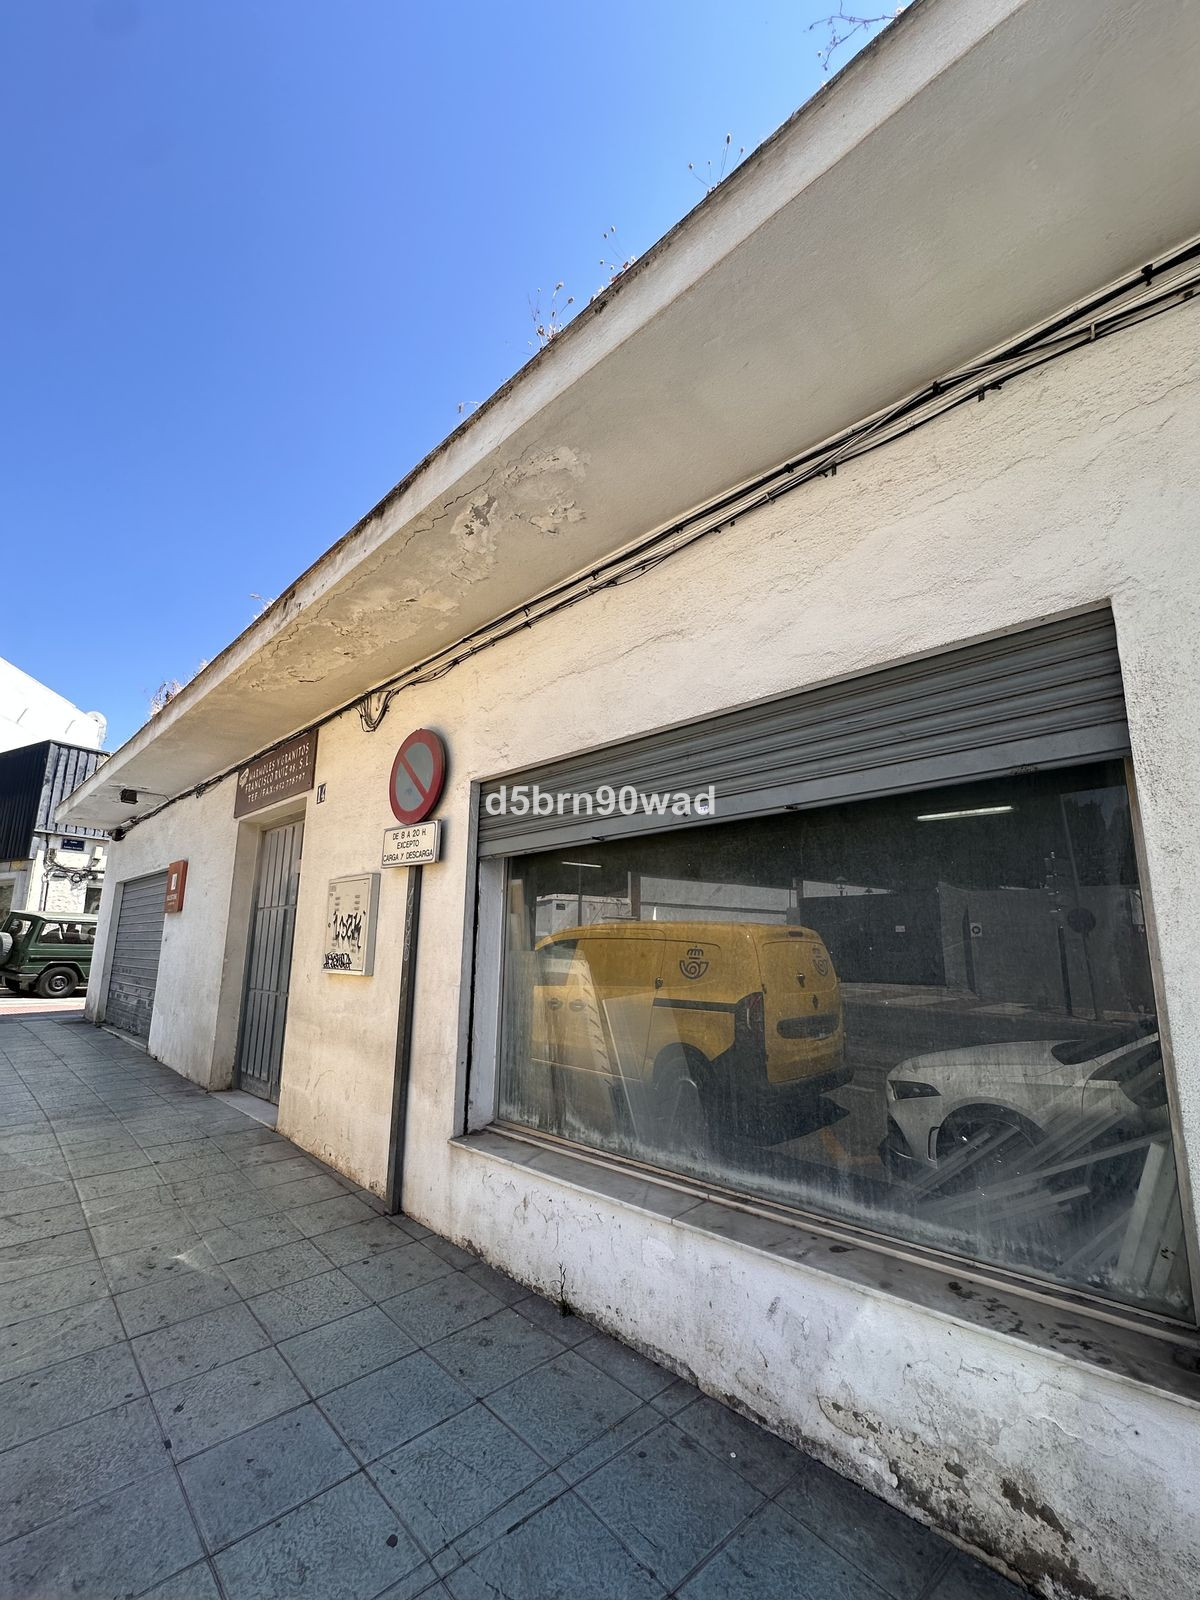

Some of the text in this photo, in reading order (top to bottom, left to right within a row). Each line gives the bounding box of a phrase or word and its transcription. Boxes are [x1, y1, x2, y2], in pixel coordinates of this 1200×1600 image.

[281, 742, 310, 766] GRANITOS
[245, 772, 274, 793] FRANCISCO
[275, 765, 289, 780] RUIZ
[392, 832, 399, 840] DE
[401, 831, 405, 839] 8
[412, 829, 420, 837] 20
[396, 839, 420, 849] EXCEPTO
[383, 853, 399, 862] CARGA
[405, 848, 433, 860] DESCARGA
